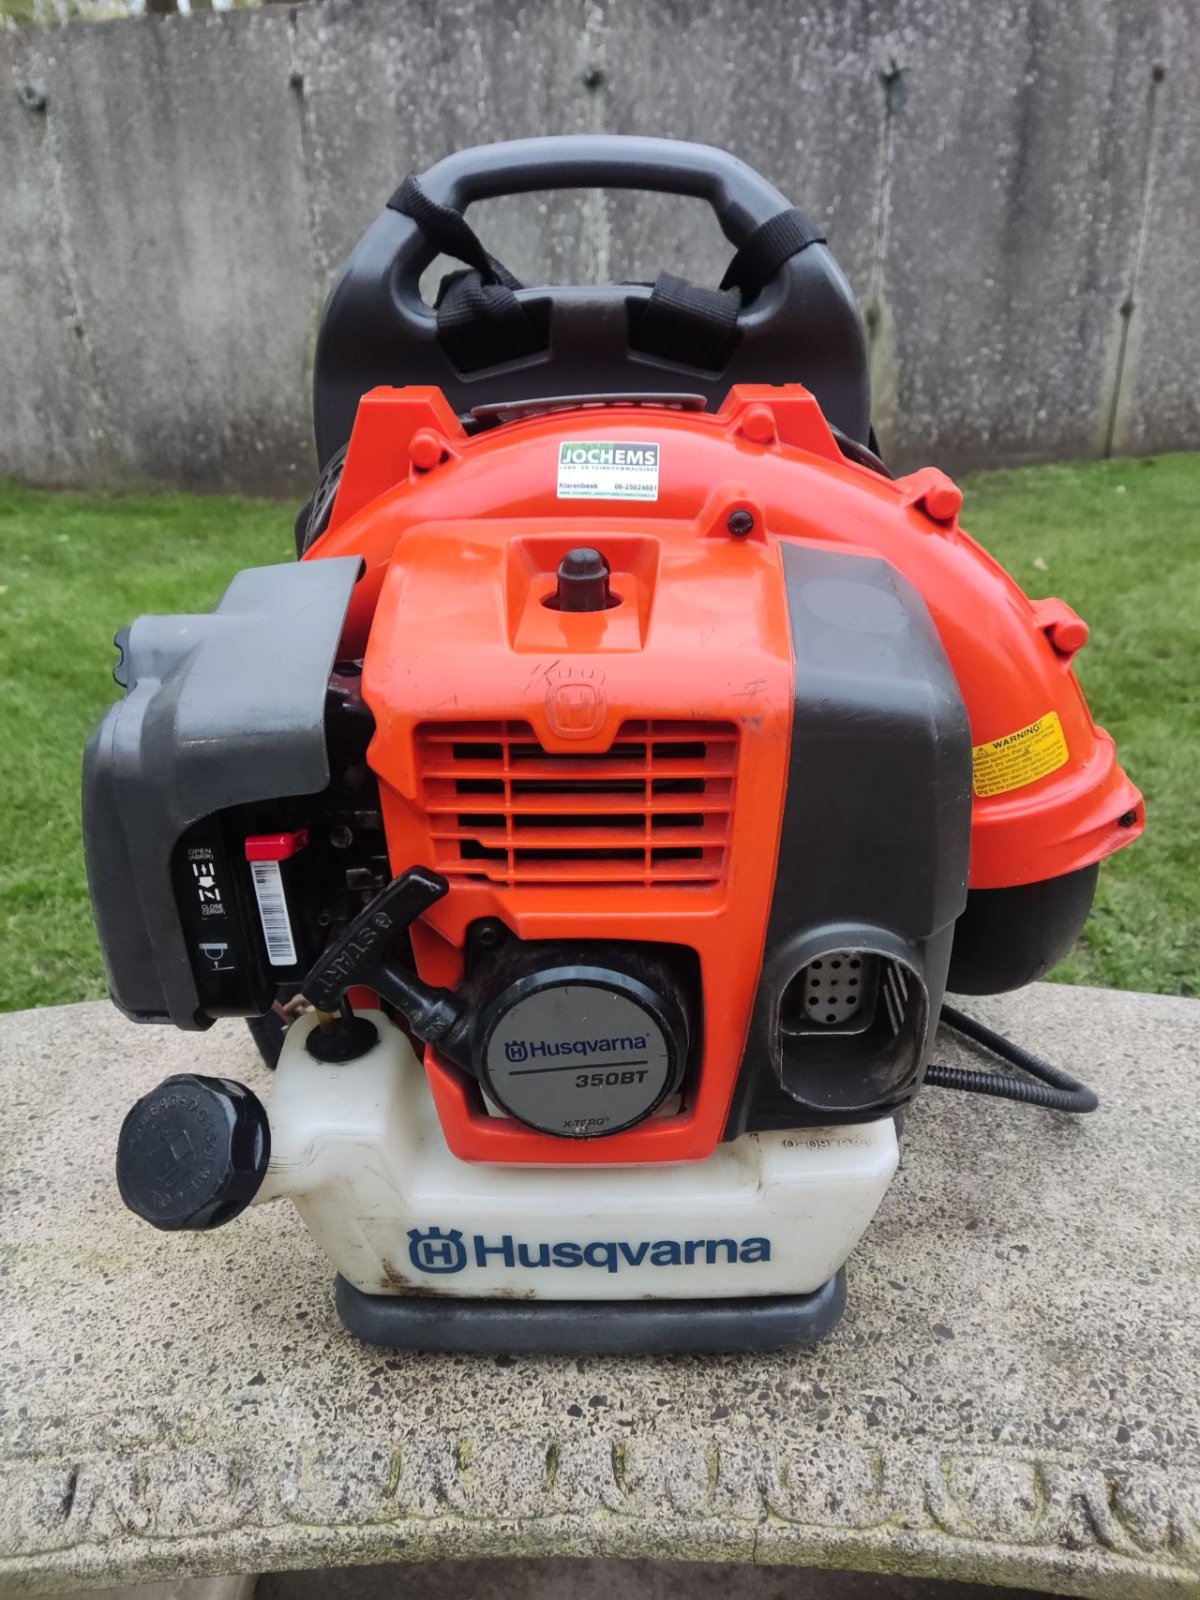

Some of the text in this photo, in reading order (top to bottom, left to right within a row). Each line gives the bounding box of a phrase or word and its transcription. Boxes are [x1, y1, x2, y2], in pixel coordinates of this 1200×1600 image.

[562, 449, 656, 465] JOCHEMS
[529, 1036, 647, 1058] Husqvarna
[575, 1070, 648, 1088] 350BT
[473, 1235, 771, 1273] Husqvarna
